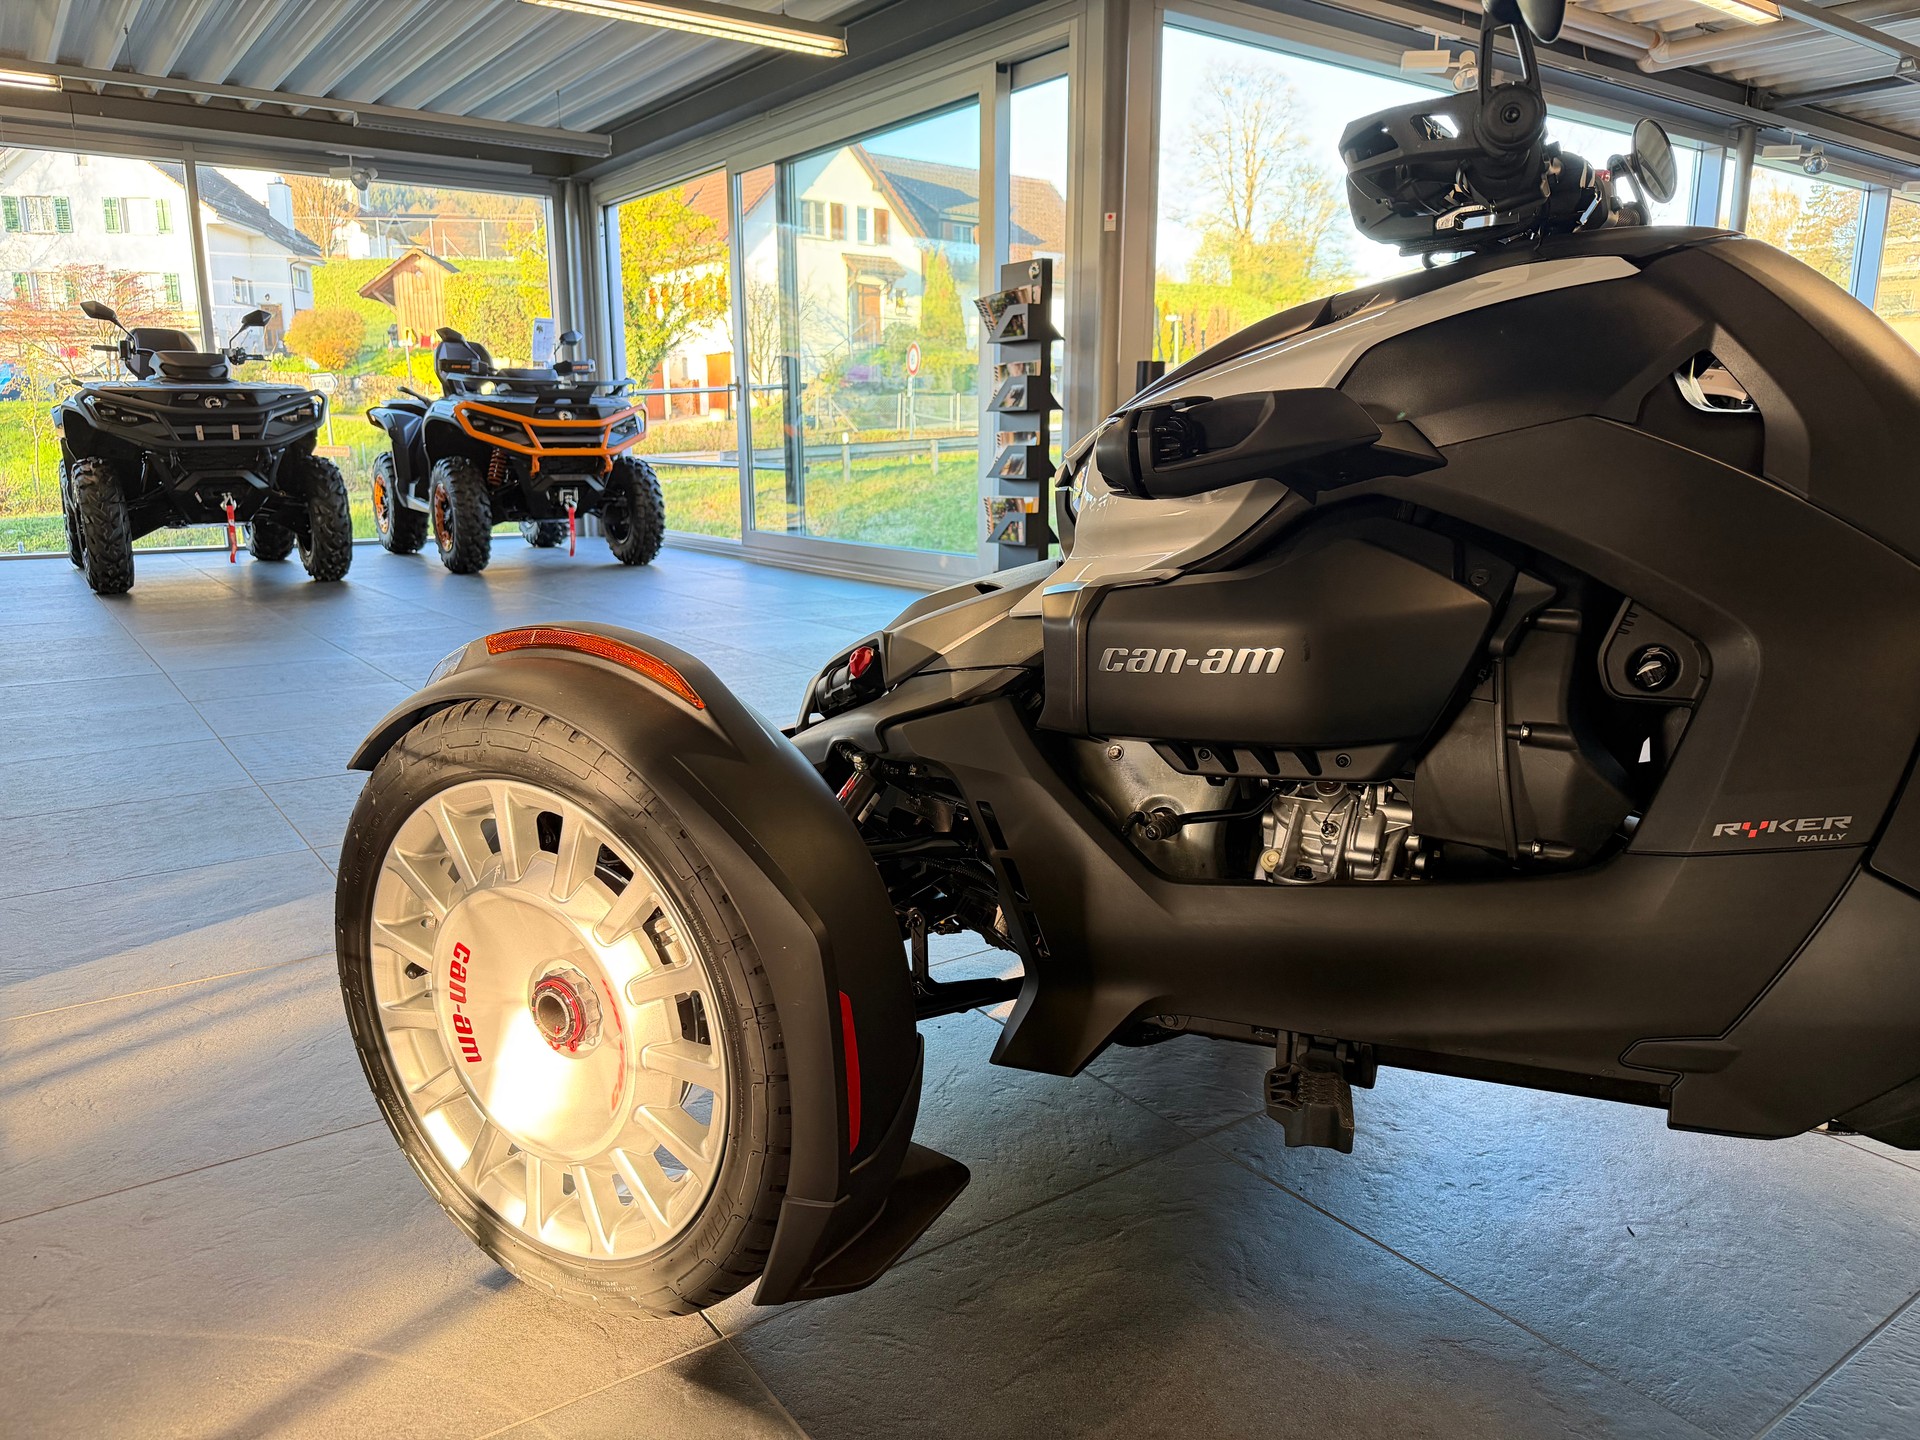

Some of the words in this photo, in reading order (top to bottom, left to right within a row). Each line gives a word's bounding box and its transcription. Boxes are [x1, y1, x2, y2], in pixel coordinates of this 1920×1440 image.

[1099, 647, 1285, 674] can-am
[1712, 815, 1853, 838] RYKER
[1797, 832, 1847, 843] RALLY
[449, 941, 482, 1063] can-am
